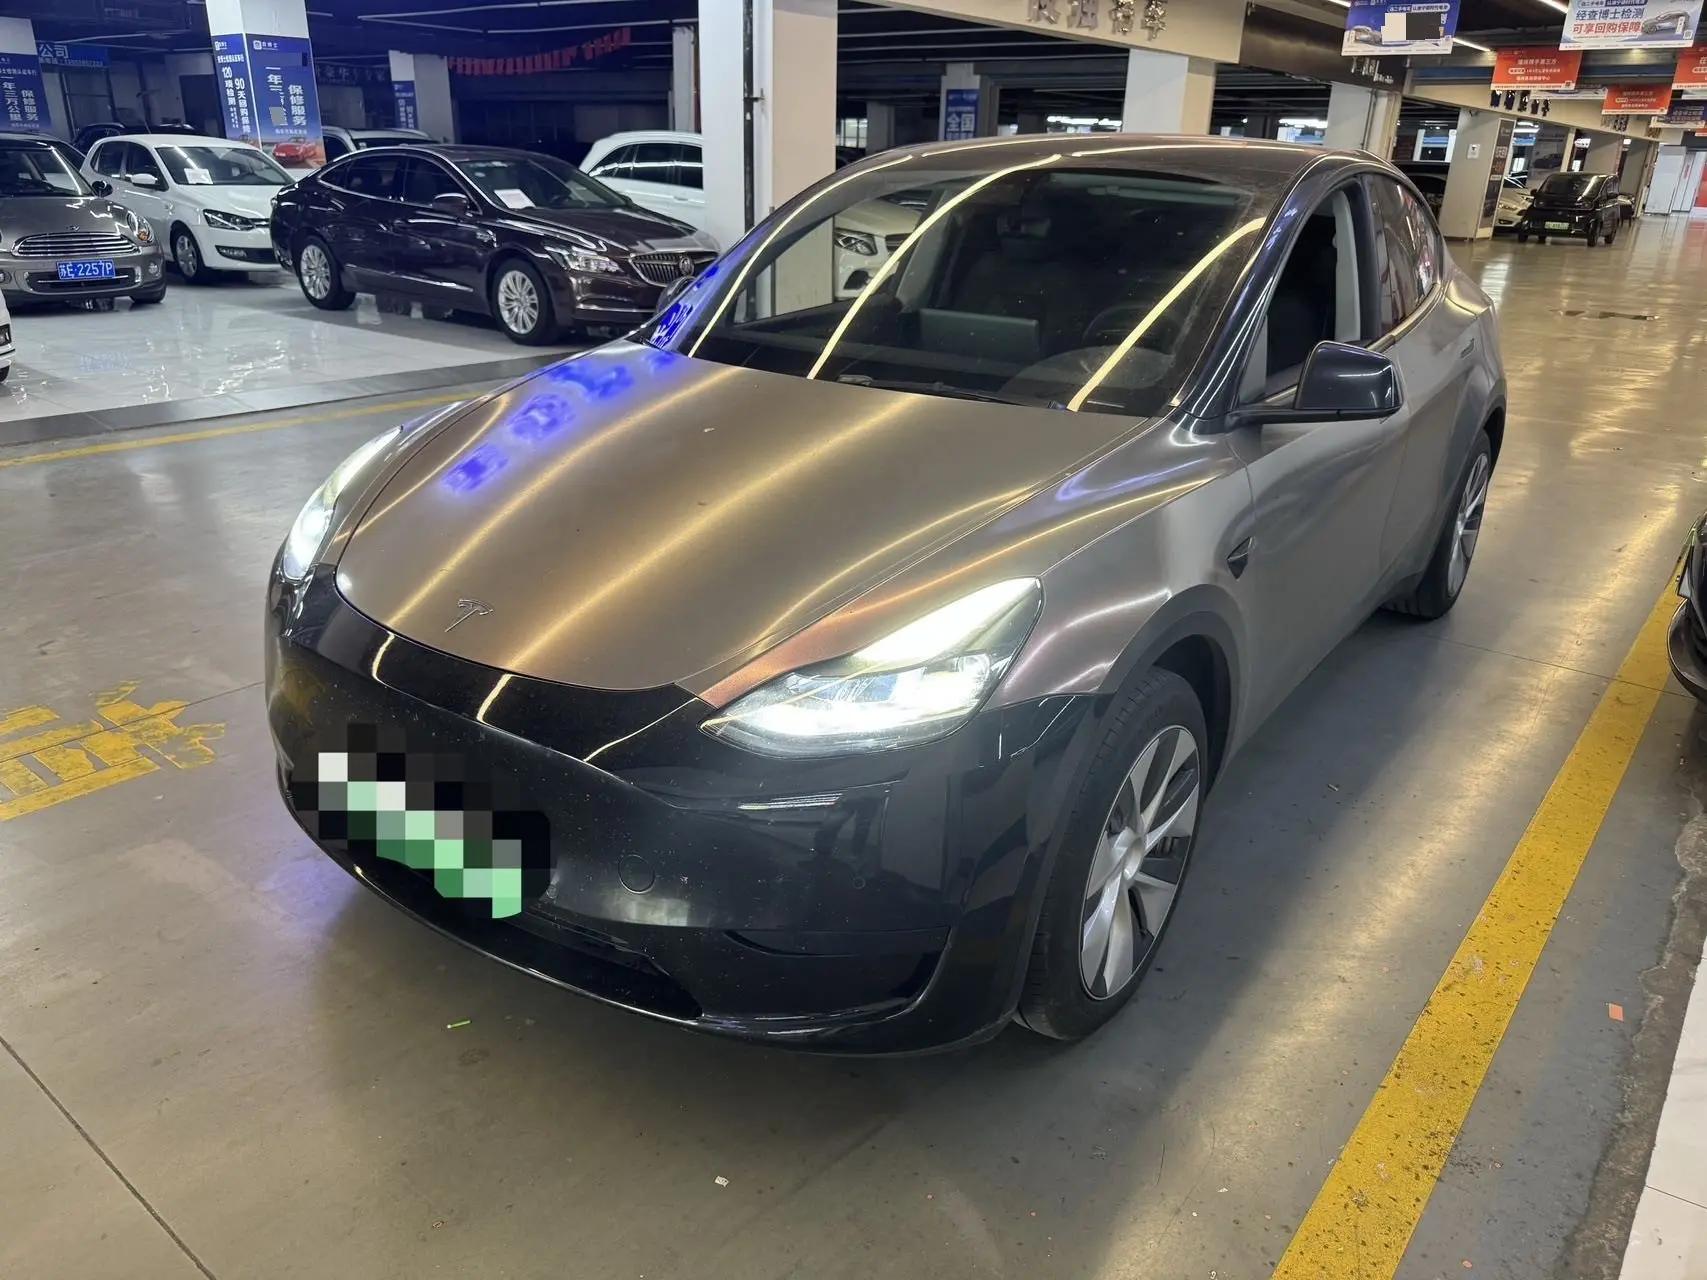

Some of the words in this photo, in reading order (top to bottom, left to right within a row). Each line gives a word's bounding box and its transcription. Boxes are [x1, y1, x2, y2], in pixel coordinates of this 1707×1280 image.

[1575, 7, 1645, 21] 经查博士检测
[1572, 21, 1643, 34] 可享回购保障
[39, 43, 69, 59] 公司
[21, 89, 39, 121] 保修服务
[288, 84, 307, 126] 保修服务
[947, 113, 975, 131] 全国
